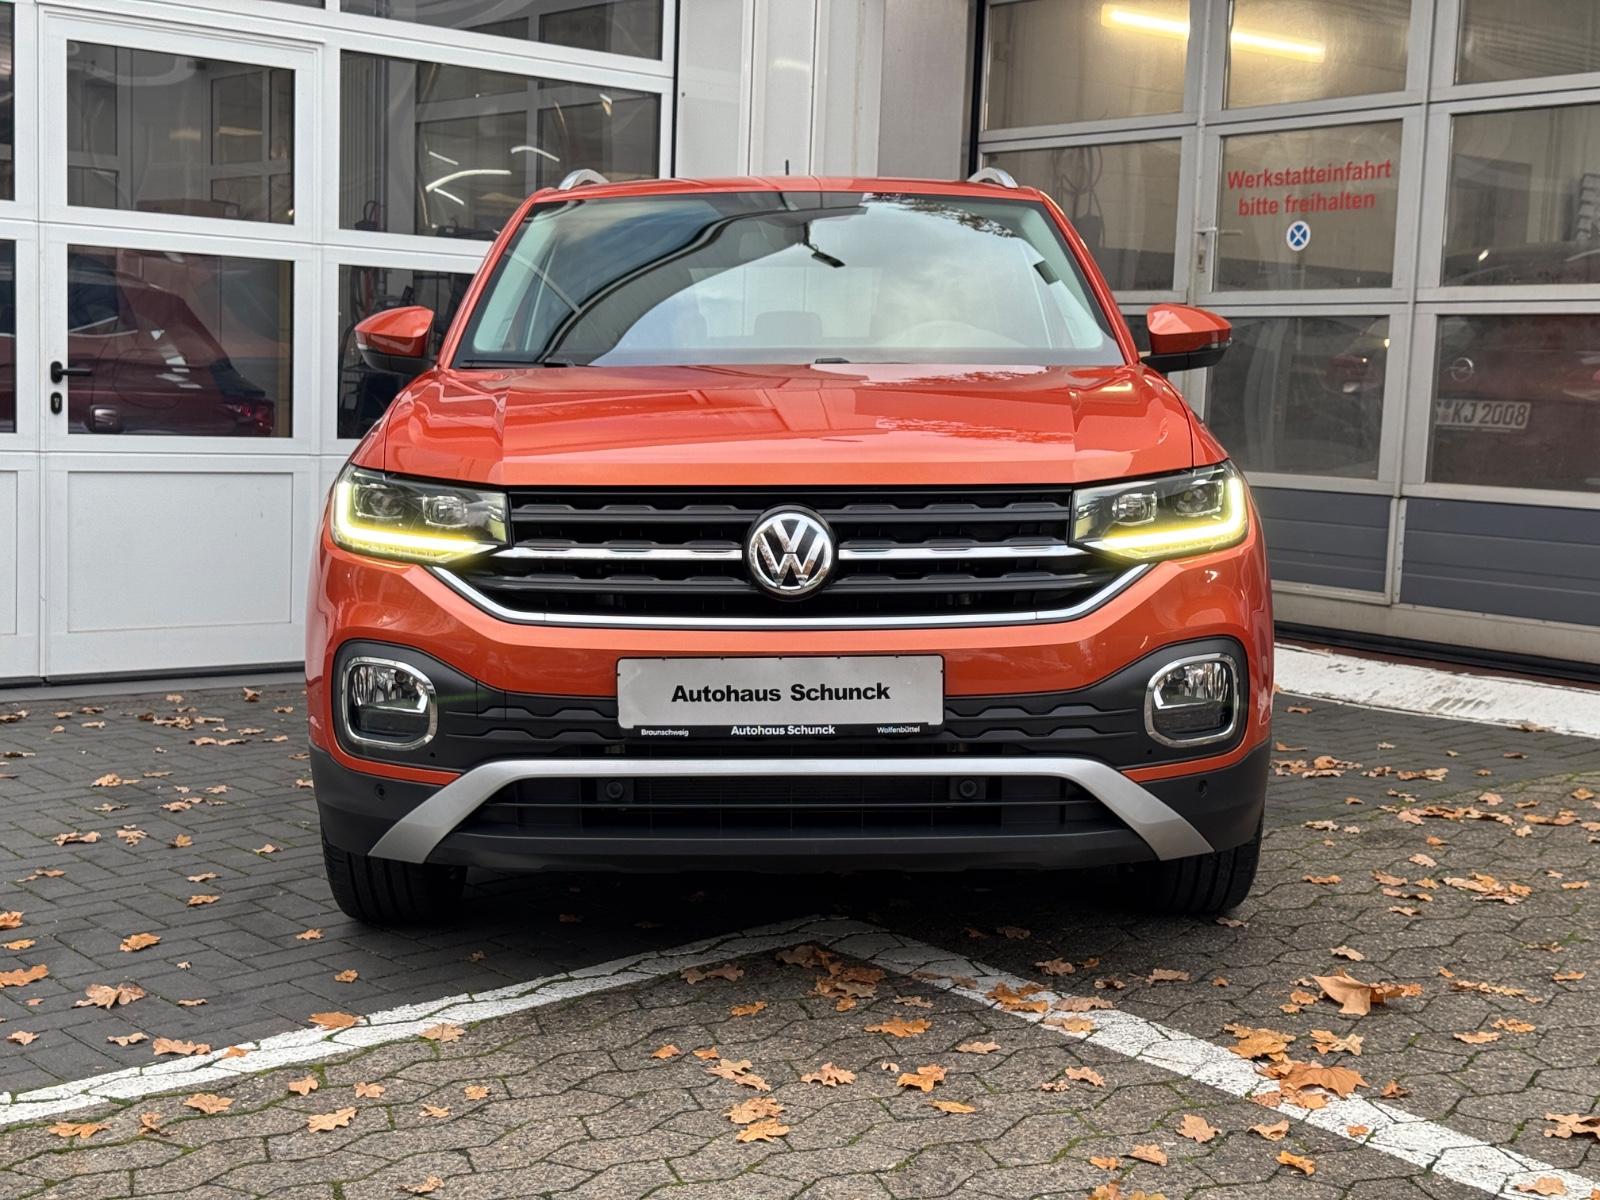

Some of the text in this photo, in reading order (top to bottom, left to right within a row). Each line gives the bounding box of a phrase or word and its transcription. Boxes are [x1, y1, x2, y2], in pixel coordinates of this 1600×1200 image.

[1228, 160, 1392, 190] Werkstatteinfahrt
[1238, 193, 1376, 216] bitte freihalten
[1479, 403, 1527, 426] 2008
[753, 514, 827, 588] VW
[671, 682, 890, 703] Autohaus Schunck
[641, 728, 689, 737] Braunschweig
[731, 725, 835, 736] Autohaus Schunck
[877, 725, 920, 734] Wolfenbüttel
